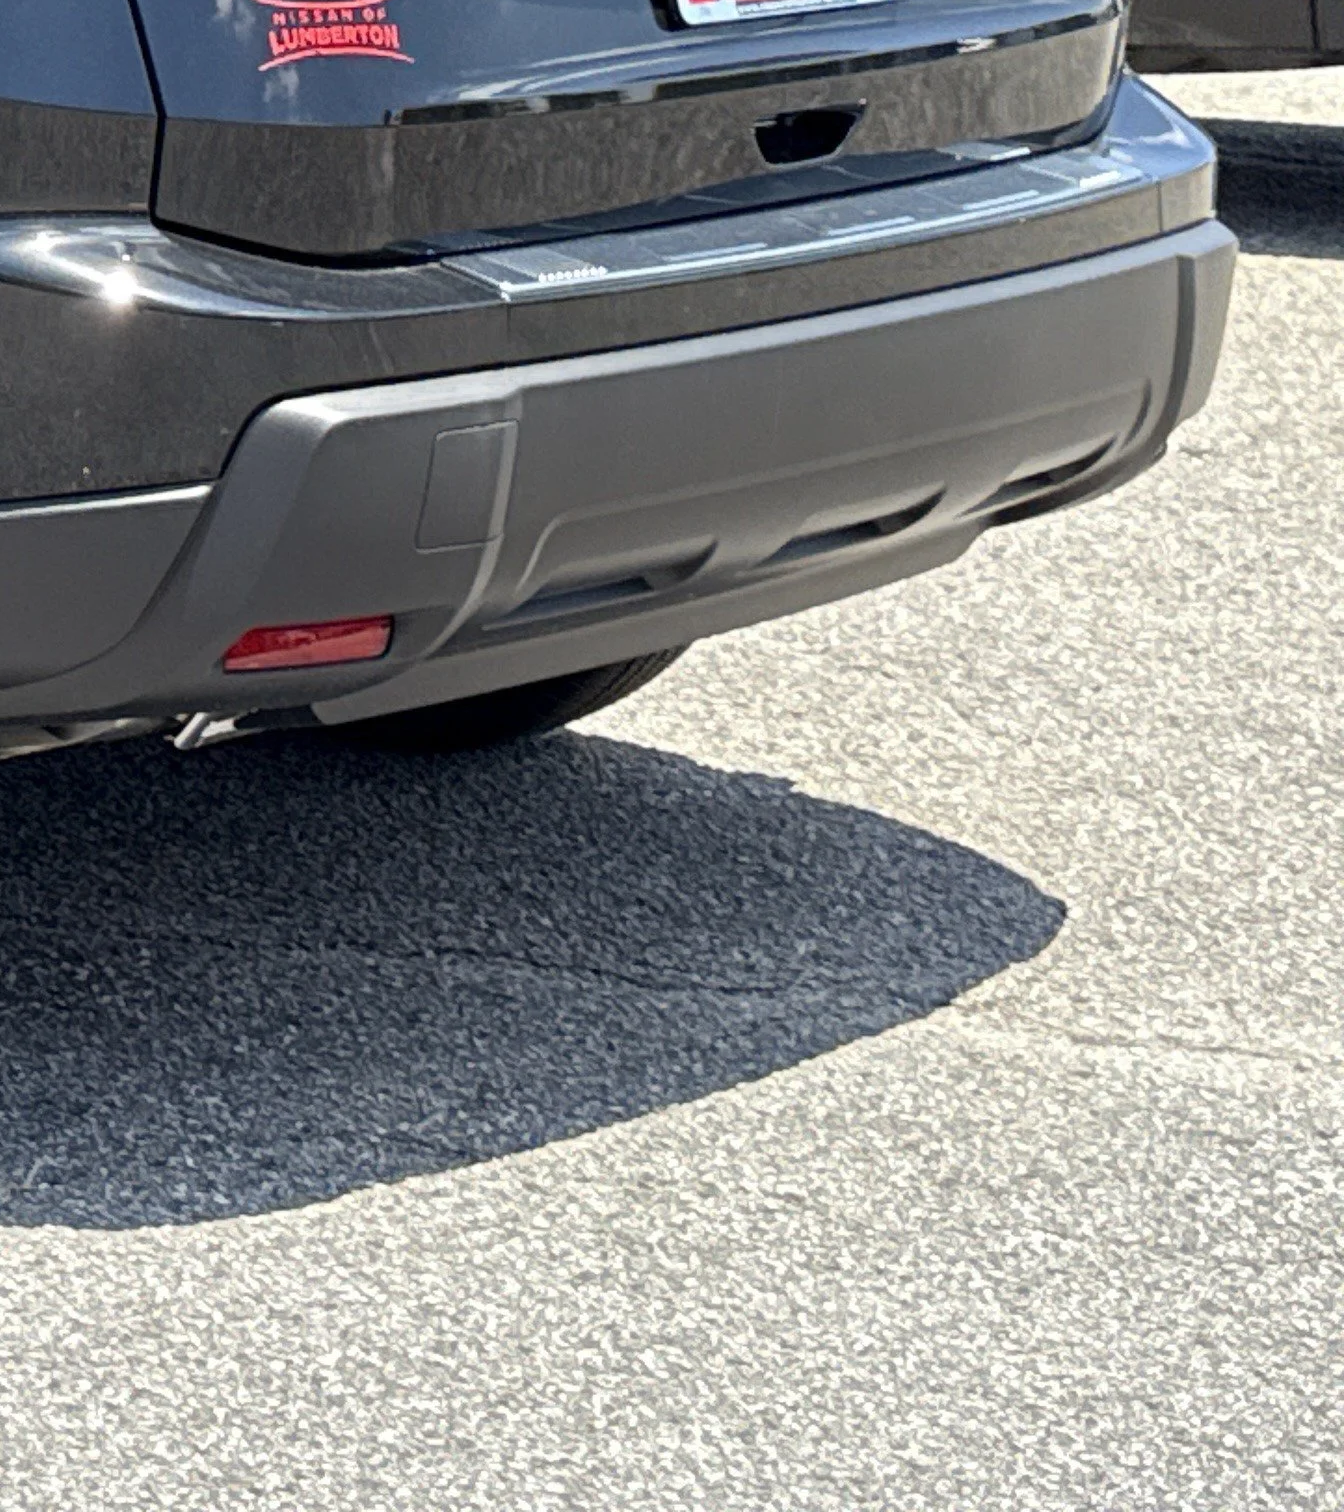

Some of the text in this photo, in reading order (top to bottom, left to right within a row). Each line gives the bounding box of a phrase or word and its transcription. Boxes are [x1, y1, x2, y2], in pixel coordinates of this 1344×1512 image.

[272, 7, 387, 26] NISSAN OF
[268, 23, 400, 56] LUMBERTON
